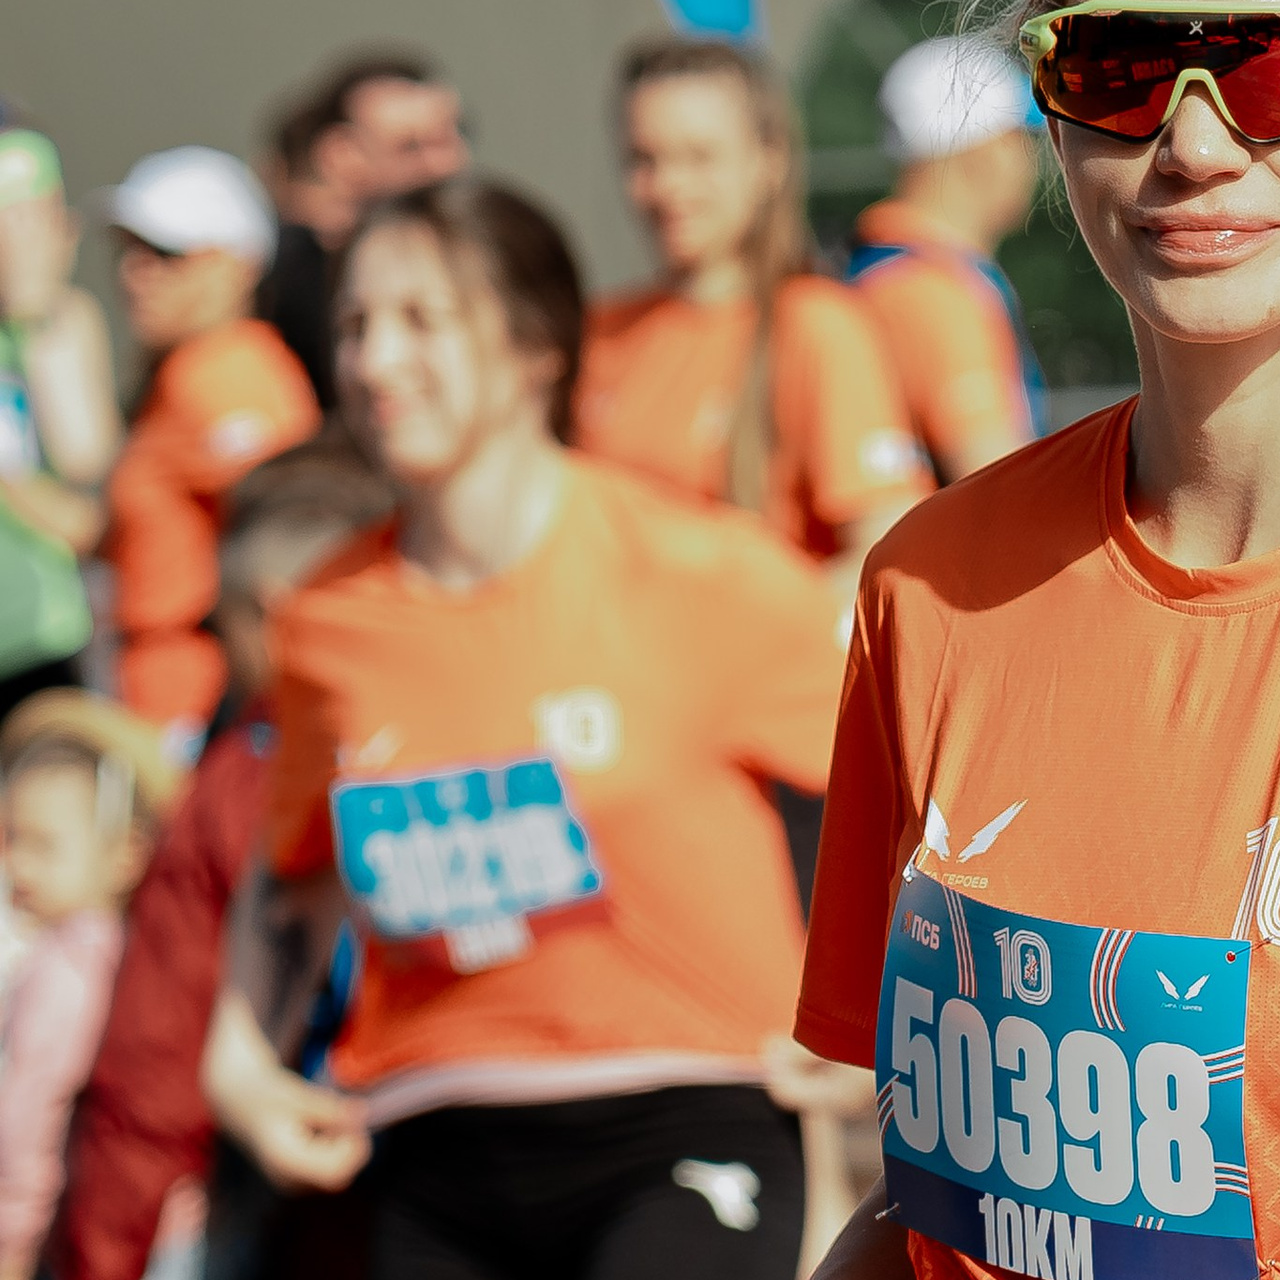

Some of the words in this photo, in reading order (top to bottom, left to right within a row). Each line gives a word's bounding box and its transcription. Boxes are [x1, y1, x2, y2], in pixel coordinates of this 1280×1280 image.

[941, 872, 989, 890] ГЕРОЕВ
[911, 914, 940, 951] ПСБ
[993, 926, 1052, 1006] 10
[892, 976, 1217, 1217] 50398
